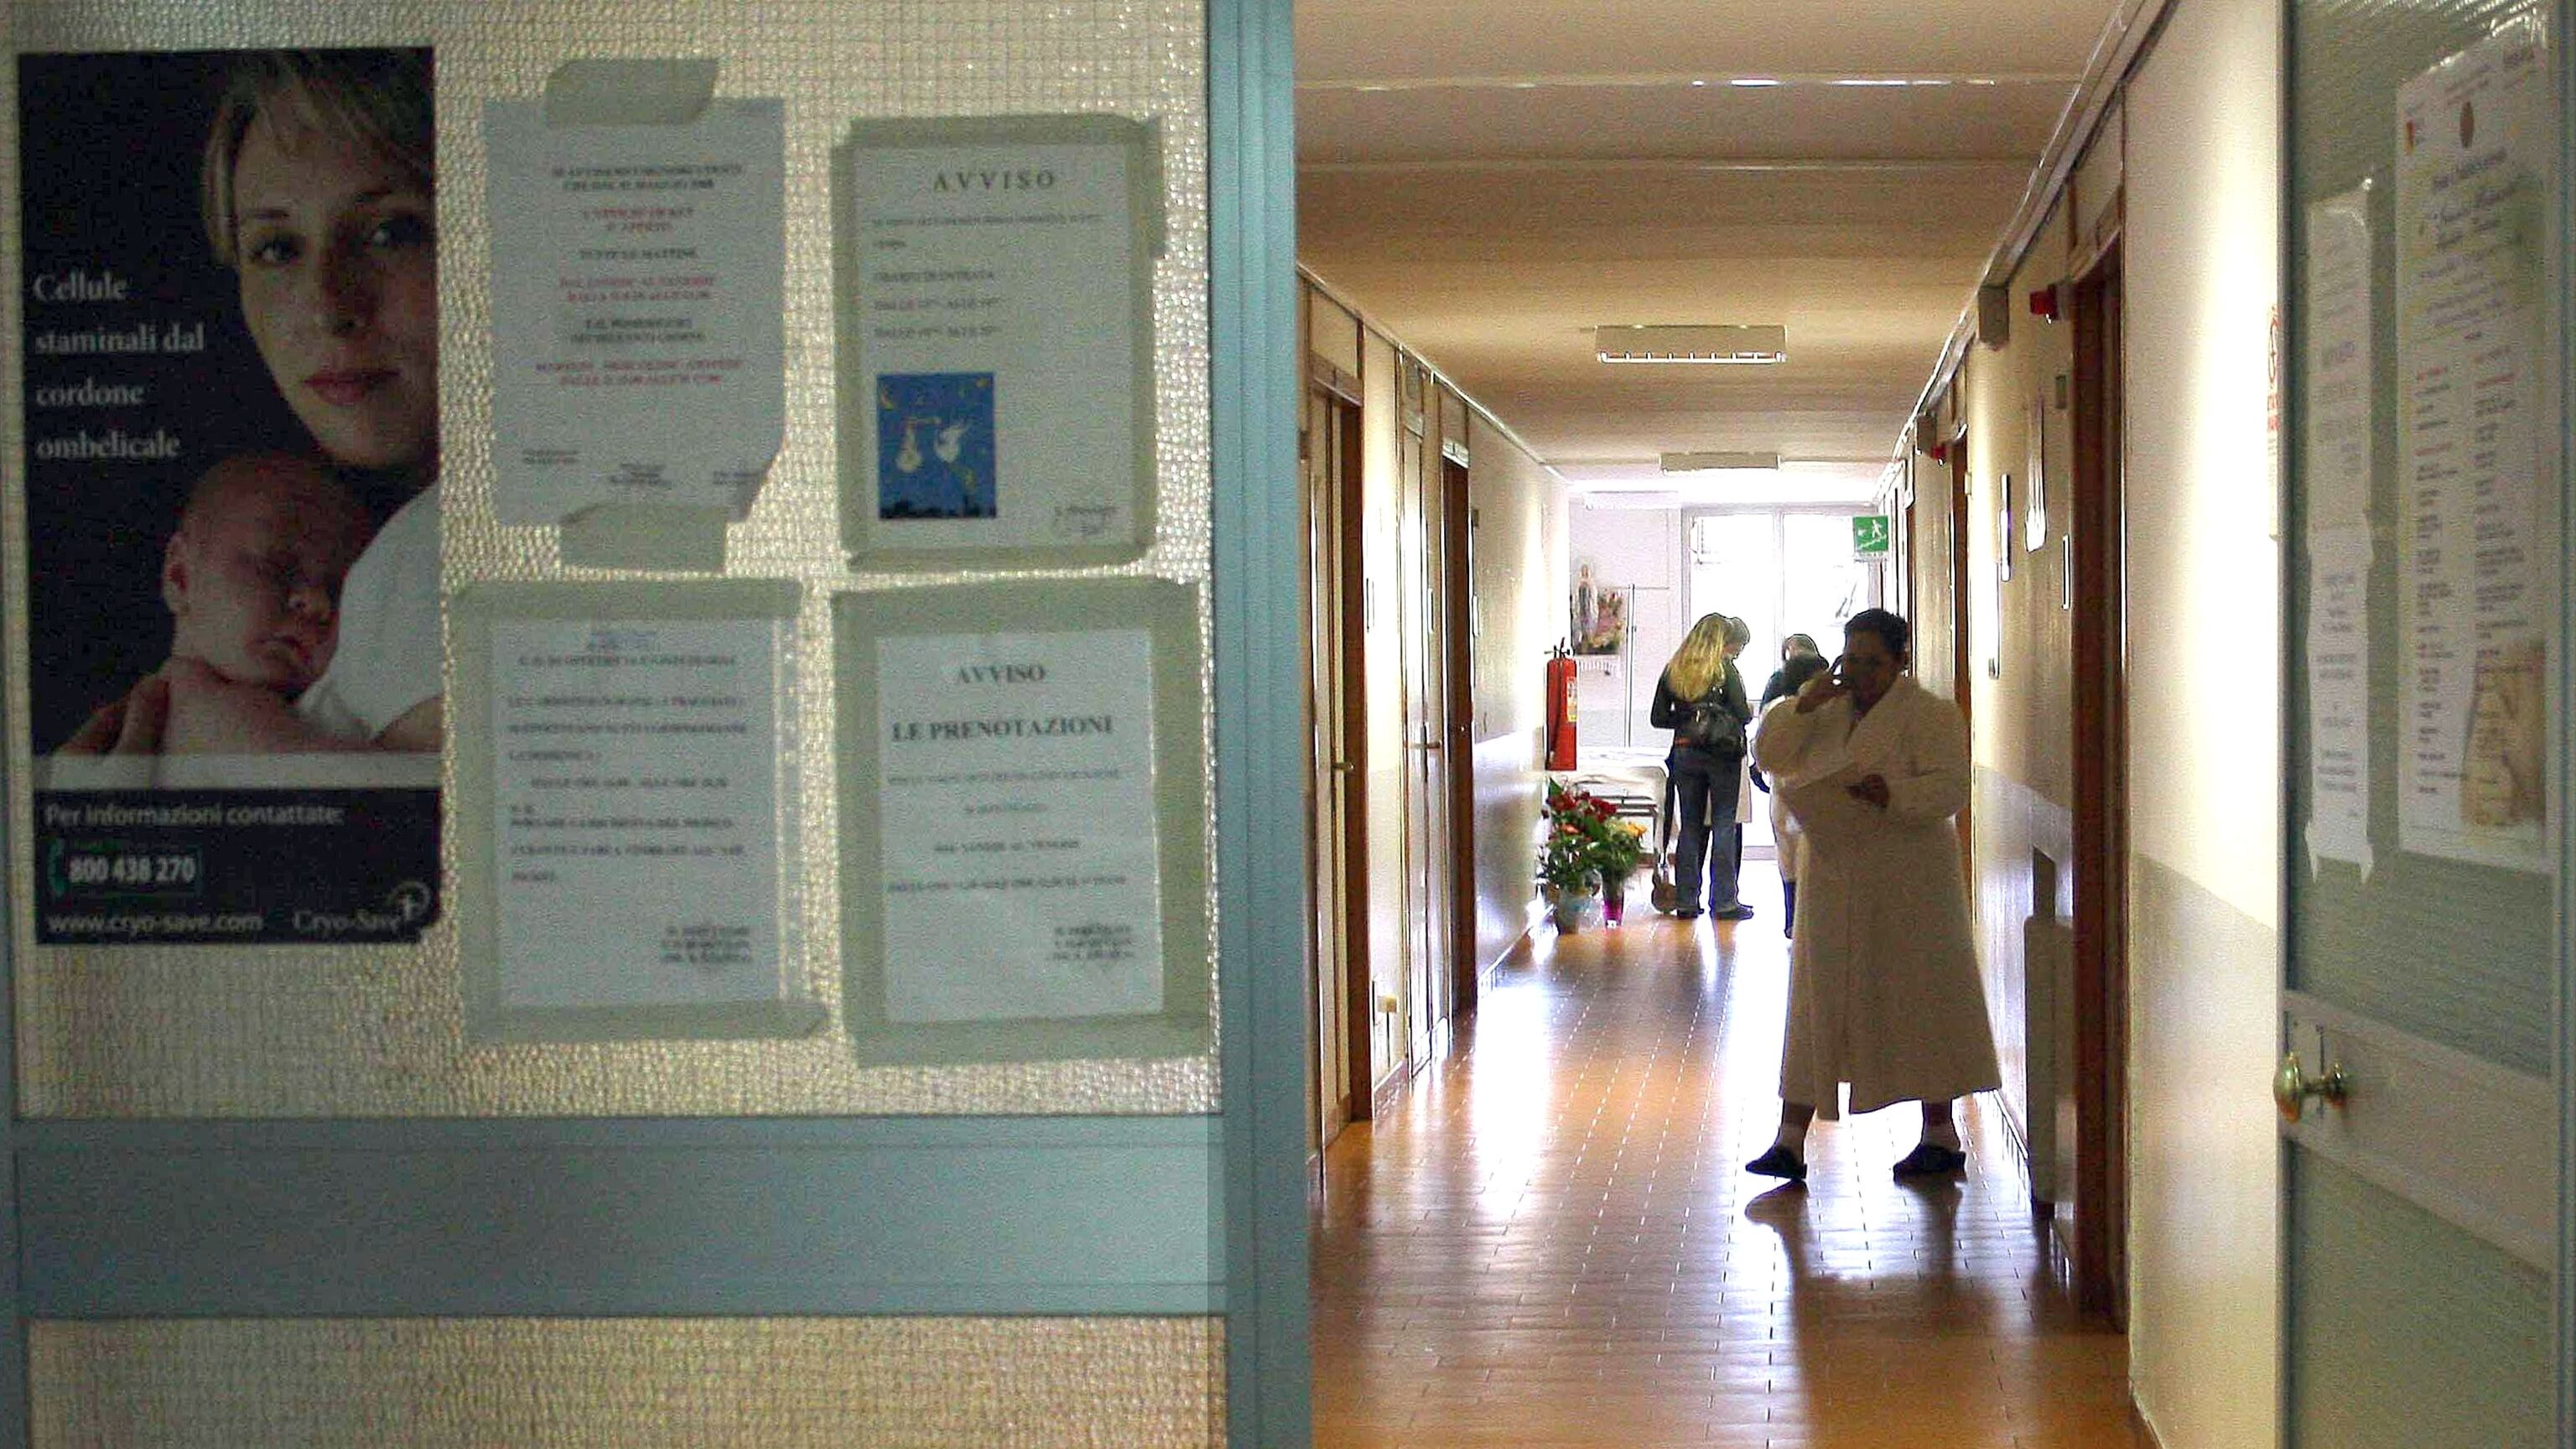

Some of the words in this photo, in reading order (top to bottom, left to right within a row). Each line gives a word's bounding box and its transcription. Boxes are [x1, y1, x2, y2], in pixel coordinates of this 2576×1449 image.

[933, 170, 1055, 192] AVVISO
[34, 269, 127, 302] Cellule
[35, 324, 158, 353] staminali
[164, 322, 205, 351] dal
[35, 377, 145, 407] cordone
[36, 429, 181, 459] ombelicale
[956, 664, 1046, 684] AVVISO
[891, 721, 923, 742] LE
[929, 714, 1114, 740] PRENOTAZIONI
[45, 805, 82, 828] Per
[86, 803, 222, 826] informazioni
[227, 803, 344, 826] contattate:
[70, 855, 108, 884] 800
[113, 855, 151, 883] 438
[156, 854, 196, 882] 270
[46, 912, 263, 937] www.cryo-save.com
